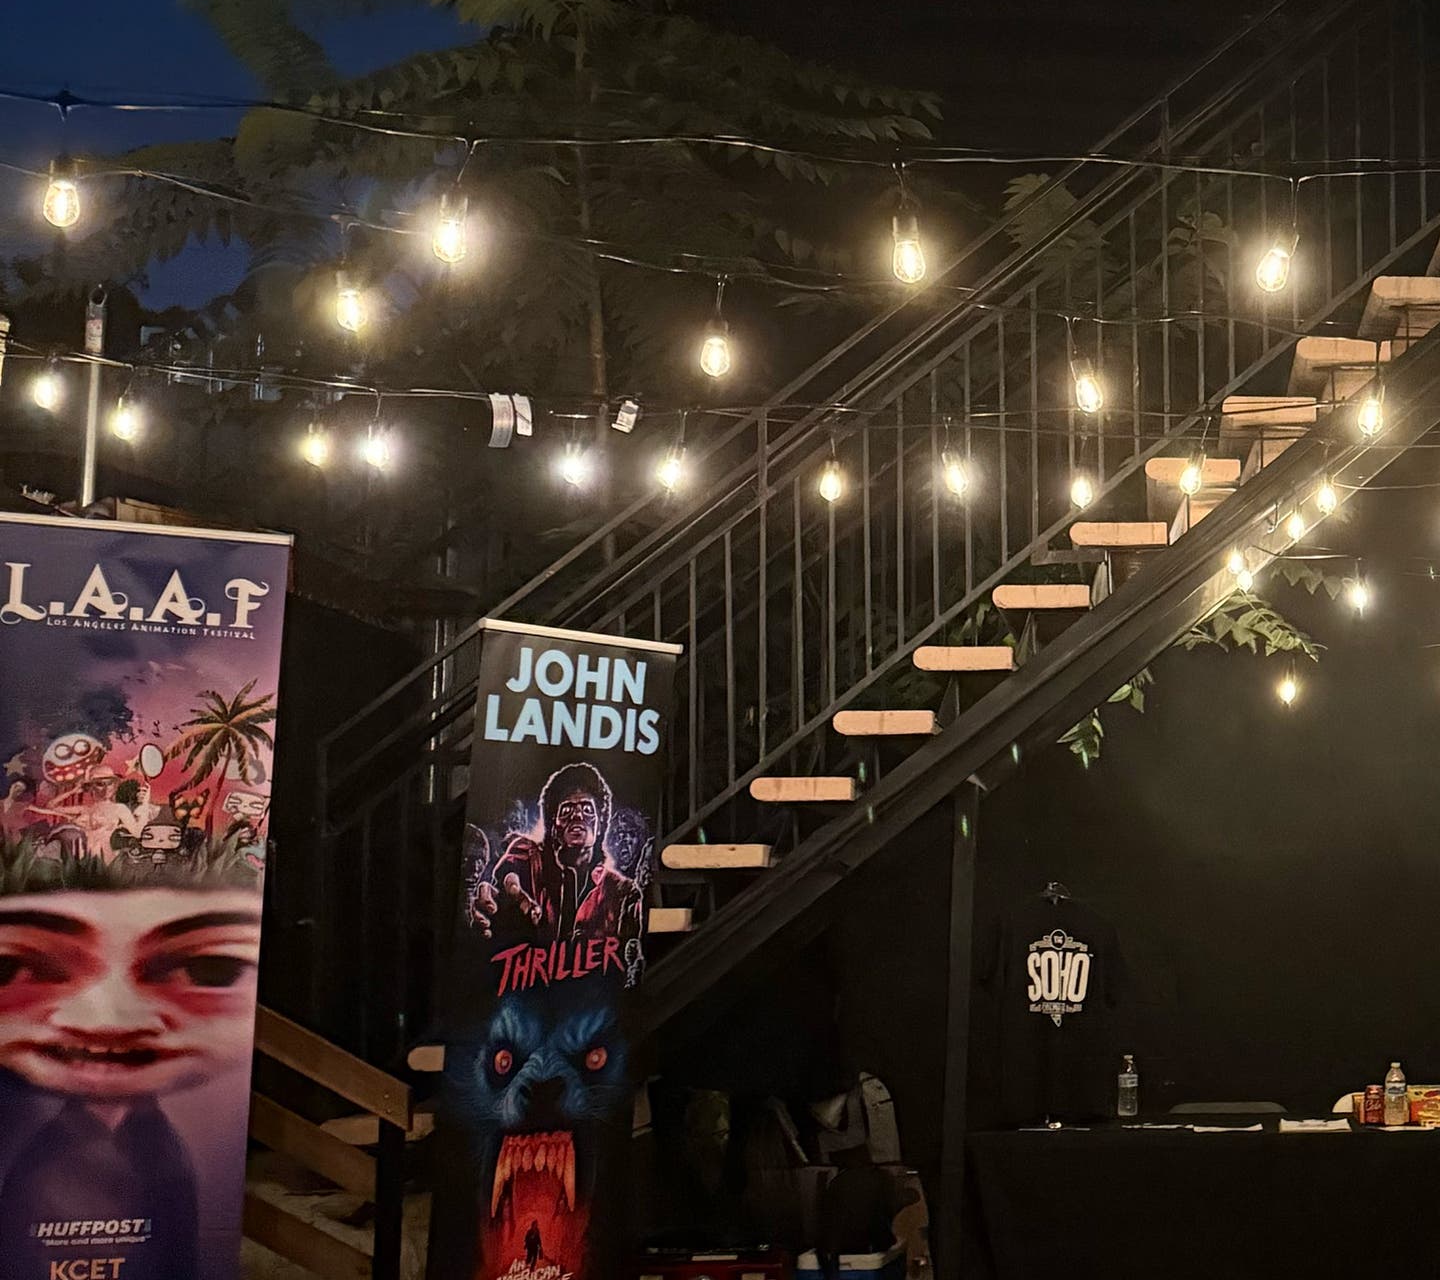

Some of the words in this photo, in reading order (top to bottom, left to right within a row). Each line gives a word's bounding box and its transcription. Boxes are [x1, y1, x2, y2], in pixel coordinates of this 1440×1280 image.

[131, 623, 197, 635] ANIMATION
[505, 647, 647, 705] JOHN
[484, 694, 660, 756] LANDIS
[490, 936, 625, 998] THRILLER
[1027, 950, 1091, 1003] SOHO
[37, 1219, 145, 1238] HUFFPOST
[508, 1258, 526, 1274] AN
